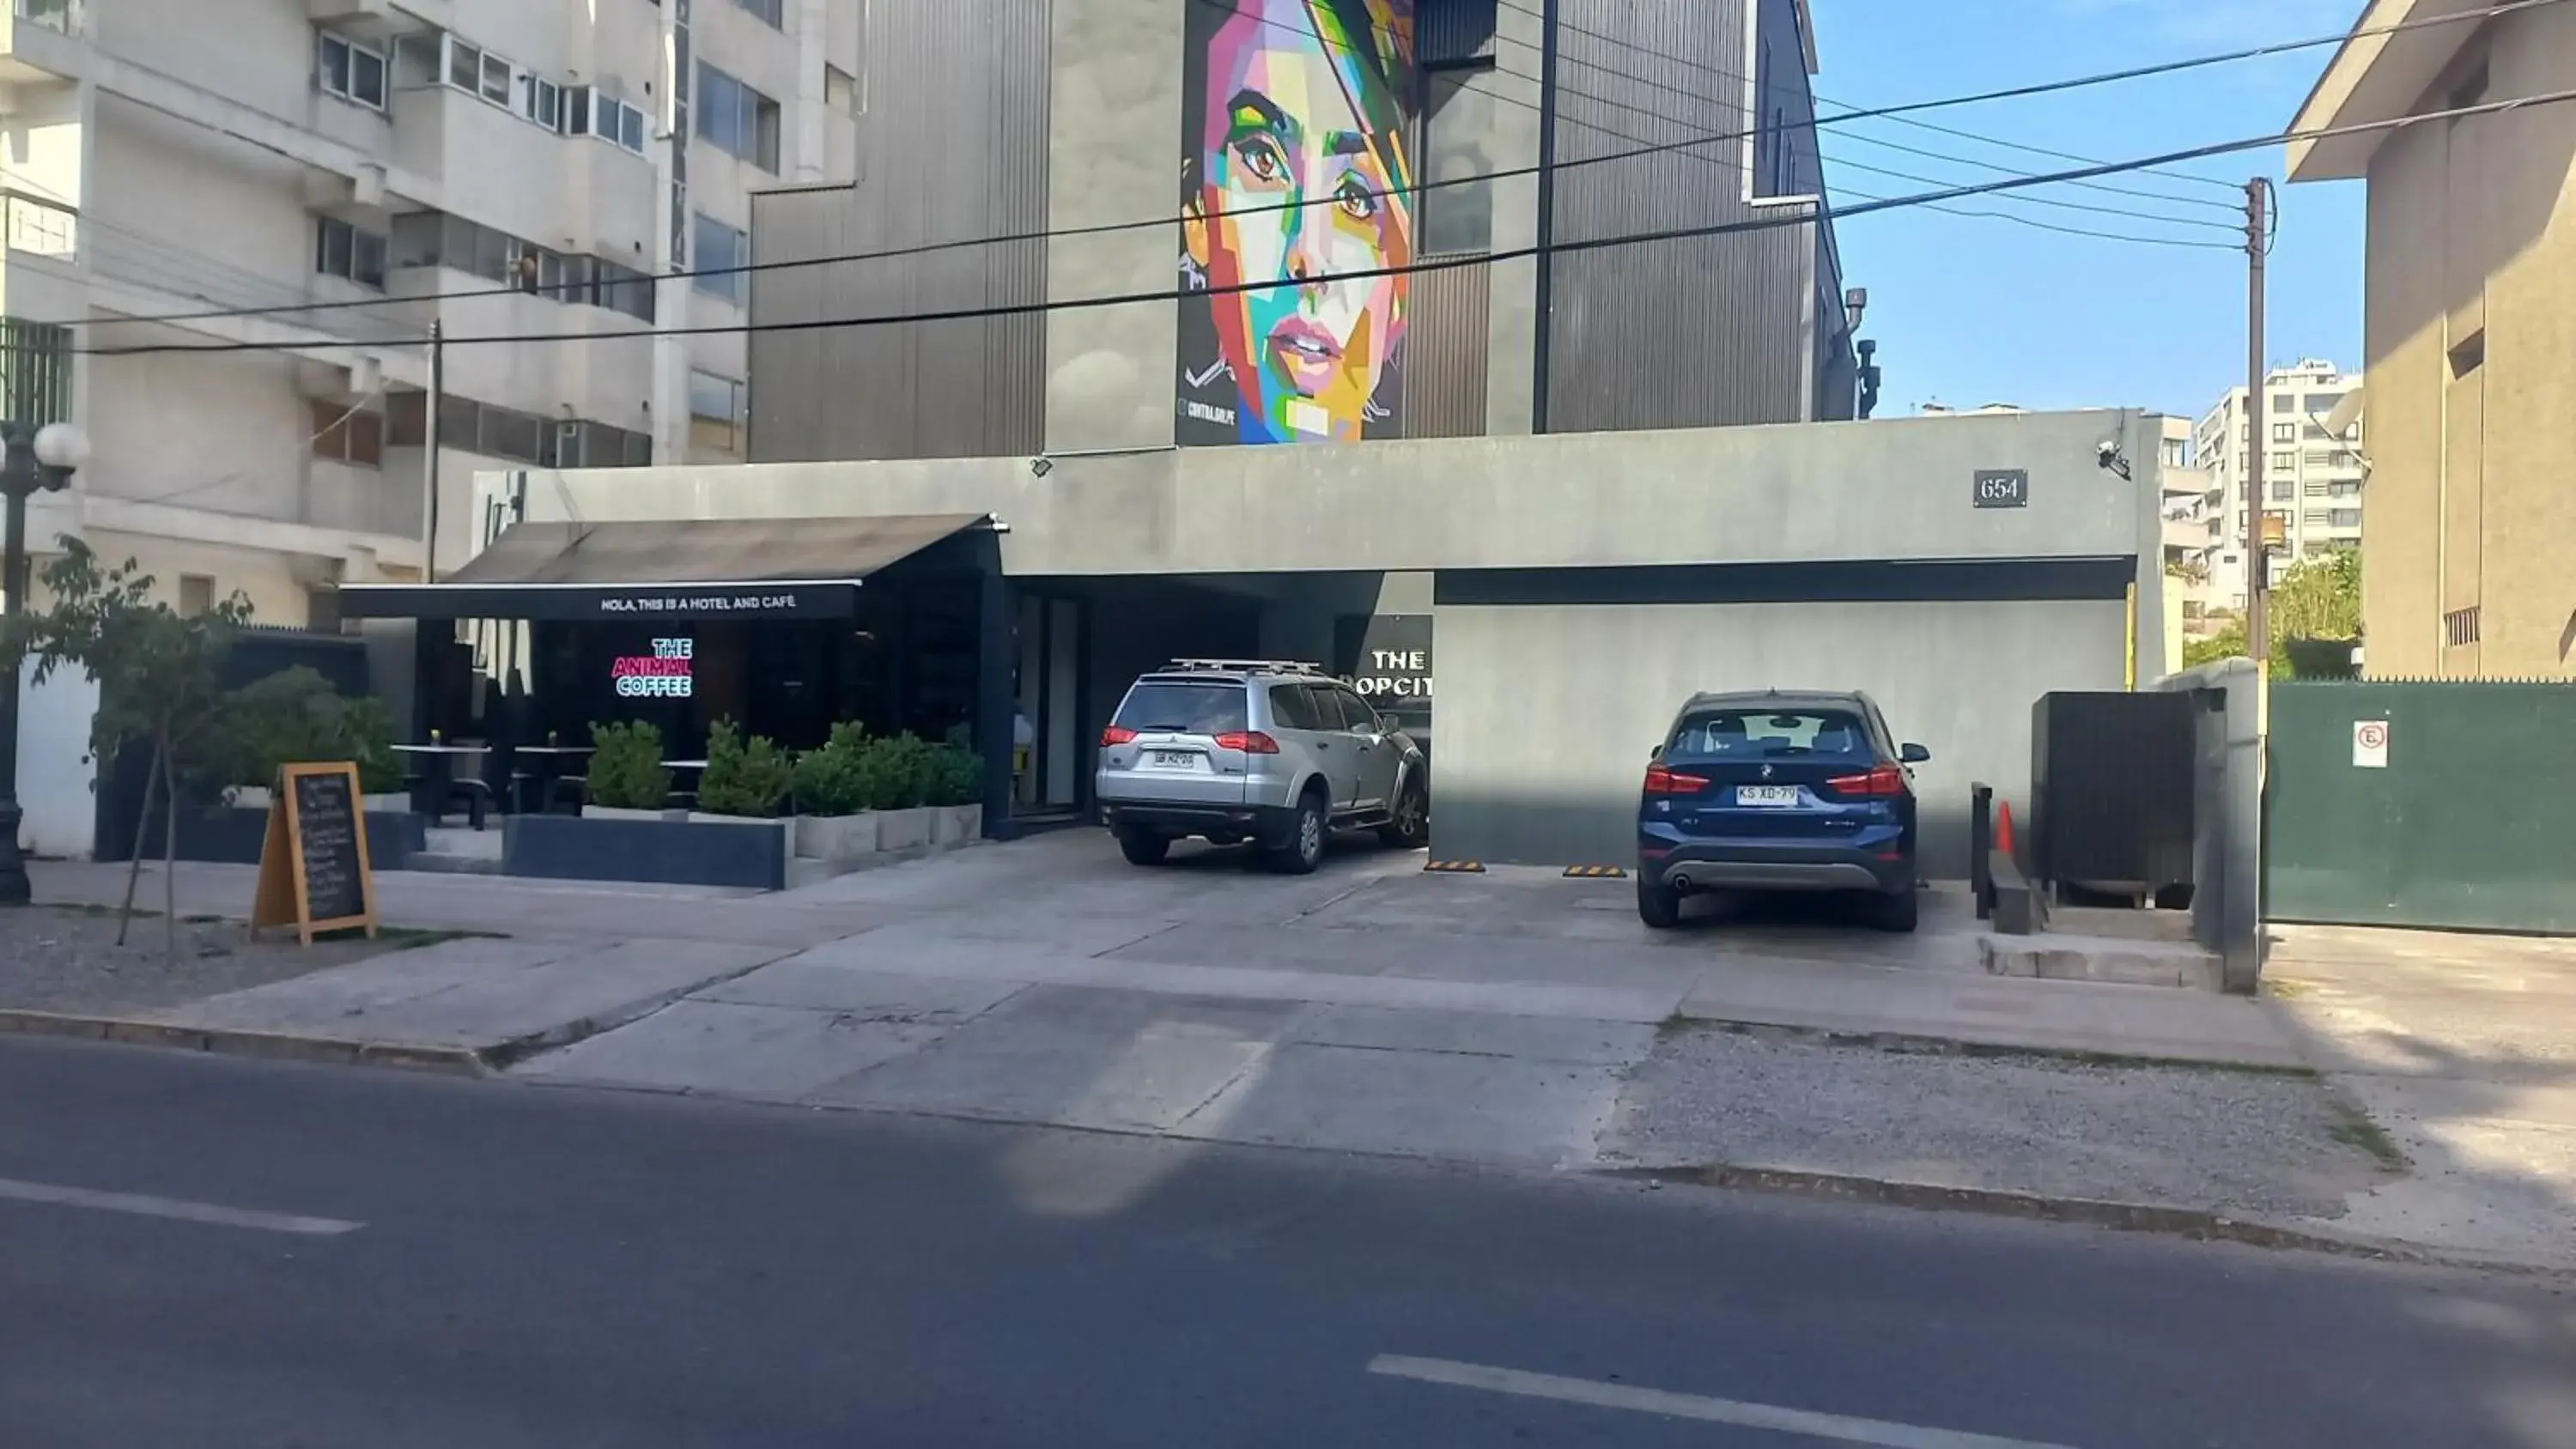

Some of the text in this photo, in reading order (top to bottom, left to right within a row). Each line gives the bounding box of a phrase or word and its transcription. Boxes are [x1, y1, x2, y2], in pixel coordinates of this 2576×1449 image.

[1981, 478, 2018, 499] 654
[637, 598, 664, 611] THIS
[665, 598, 677, 610] IS
[677, 597, 689, 610] A
[690, 597, 731, 610] HOTEL
[733, 596, 760, 609] AND
[651, 638, 693, 660] THE
[611, 657, 692, 678] ANIMAL
[1372, 651, 1425, 670] THE
[616, 676, 692, 697] COFFEE
